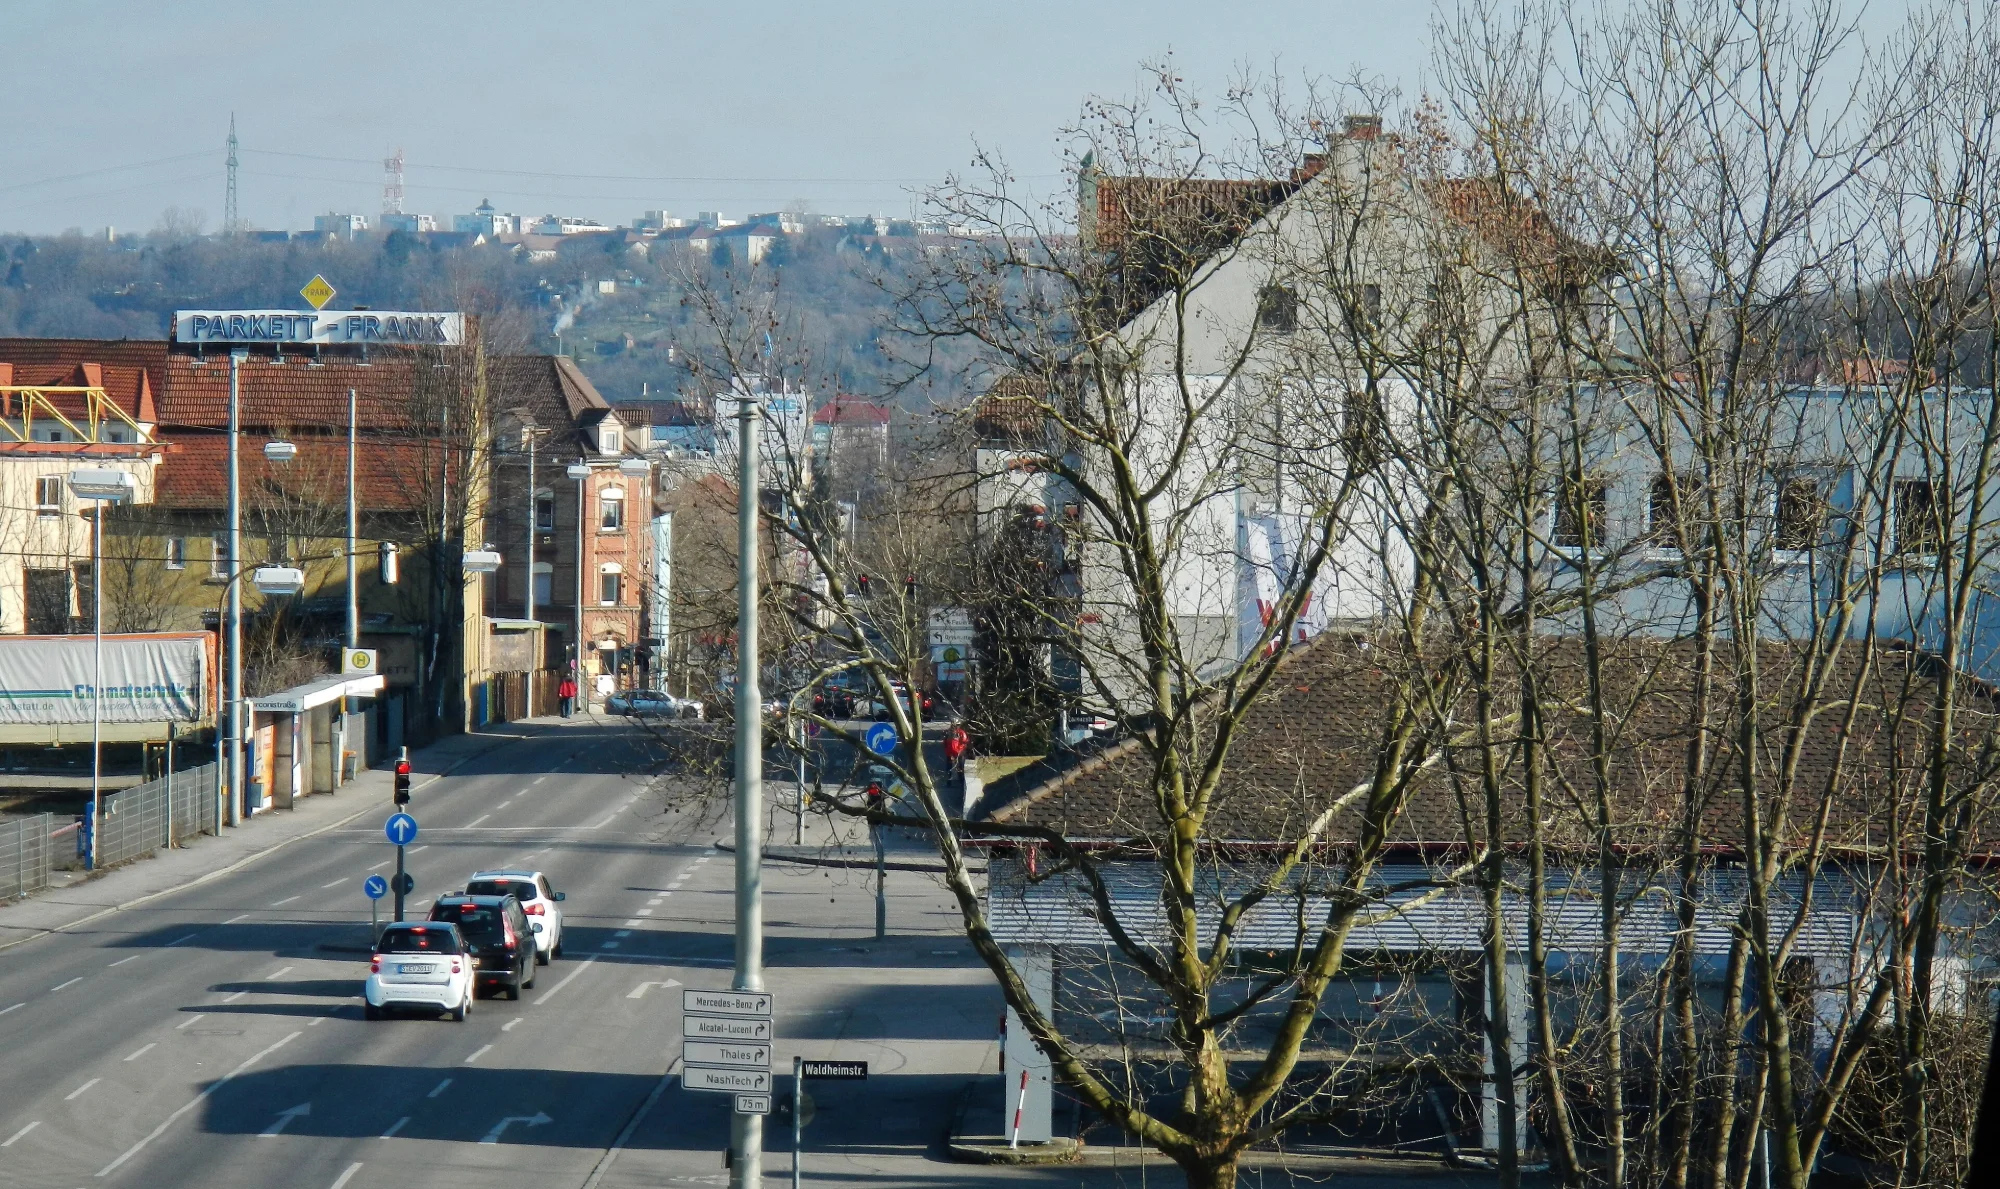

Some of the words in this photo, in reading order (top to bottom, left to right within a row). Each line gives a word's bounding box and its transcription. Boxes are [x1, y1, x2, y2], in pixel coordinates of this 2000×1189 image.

[305, 288, 329, 297] FRANK
[192, 315, 319, 339] PARKETT
[346, 316, 447, 342] FRANK
[0, 702, 54, 711] -abstatt.de
[255, 700, 297, 709] rconistraße
[696, 997, 752, 1010] Mercedes-Benz
[698, 1022, 752, 1034] Alcatel-Lucent
[720, 1048, 751, 1060] Thales
[805, 1063, 865, 1076] Waldheimstr.
[706, 1074, 752, 1086] NashTech
[742, 1099, 753, 1109] 75
[754, 1101, 764, 1109] m
